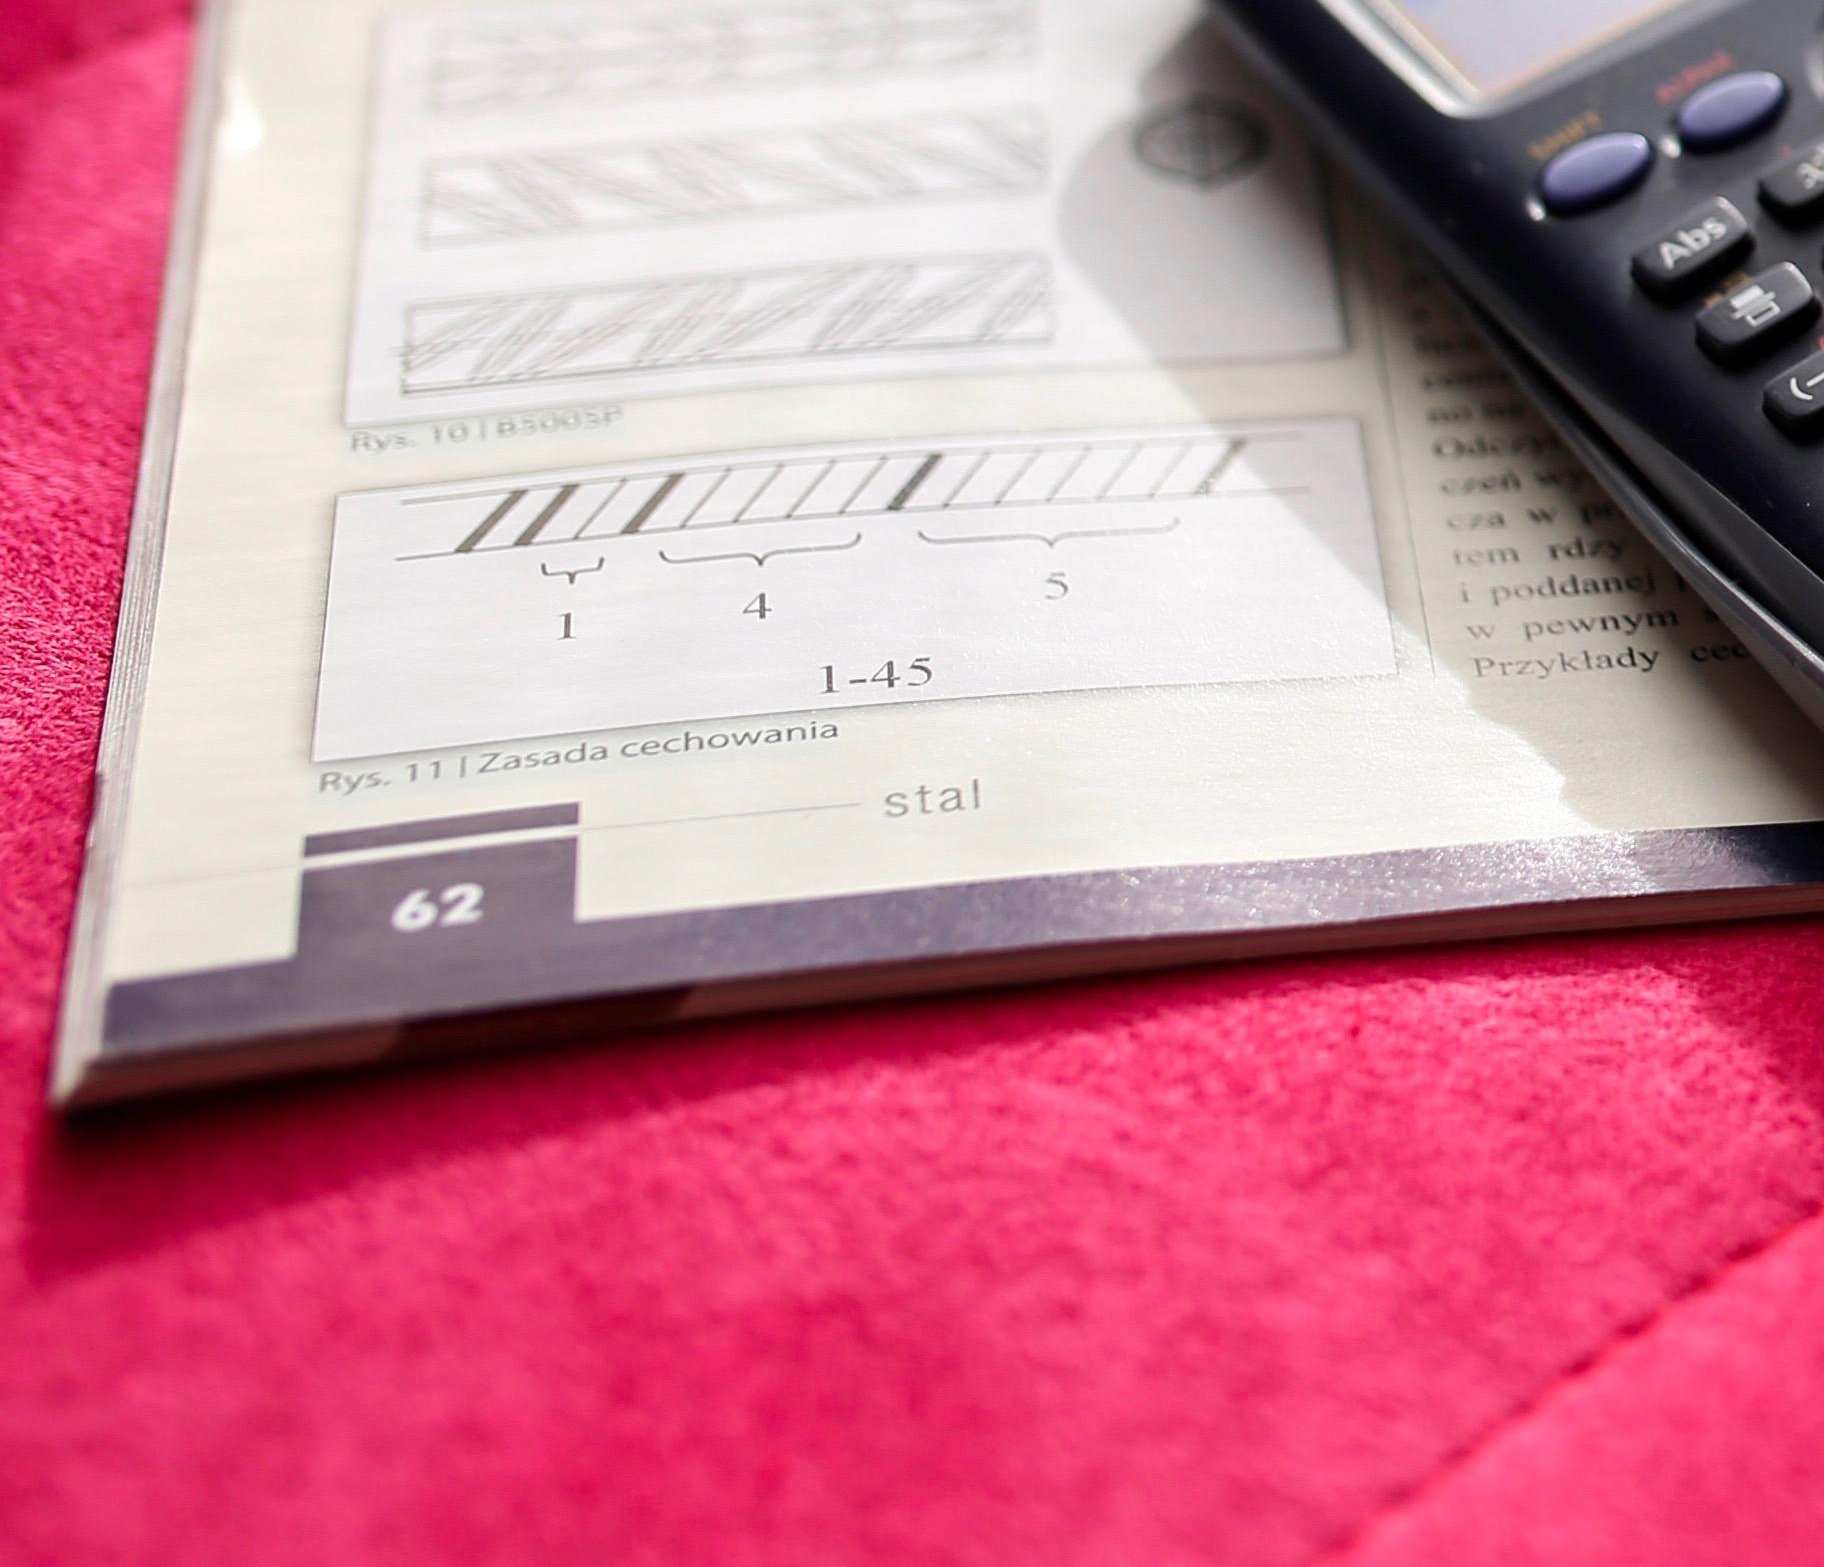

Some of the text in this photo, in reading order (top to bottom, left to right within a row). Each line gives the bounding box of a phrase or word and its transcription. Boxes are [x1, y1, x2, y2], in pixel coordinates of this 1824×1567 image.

[1657, 210, 1728, 270] Abs
[433, 421, 469, 444] 10
[1454, 545, 1520, 566] tem
[556, 571, 1070, 641] 1 4 5
[1458, 573, 1657, 607] i poddanej
[1466, 624, 1498, 641] w
[1522, 606, 1680, 642] pewnym
[818, 655, 935, 695] 1-45
[1472, 646, 1660, 680] Przykłady
[318, 770, 392, 797] Rys.
[405, 759, 443, 783] 11
[476, 740, 609, 775] Zasada
[620, 719, 840, 760] cechowania
[882, 777, 983, 820] stal
[391, 881, 486, 931] 62
